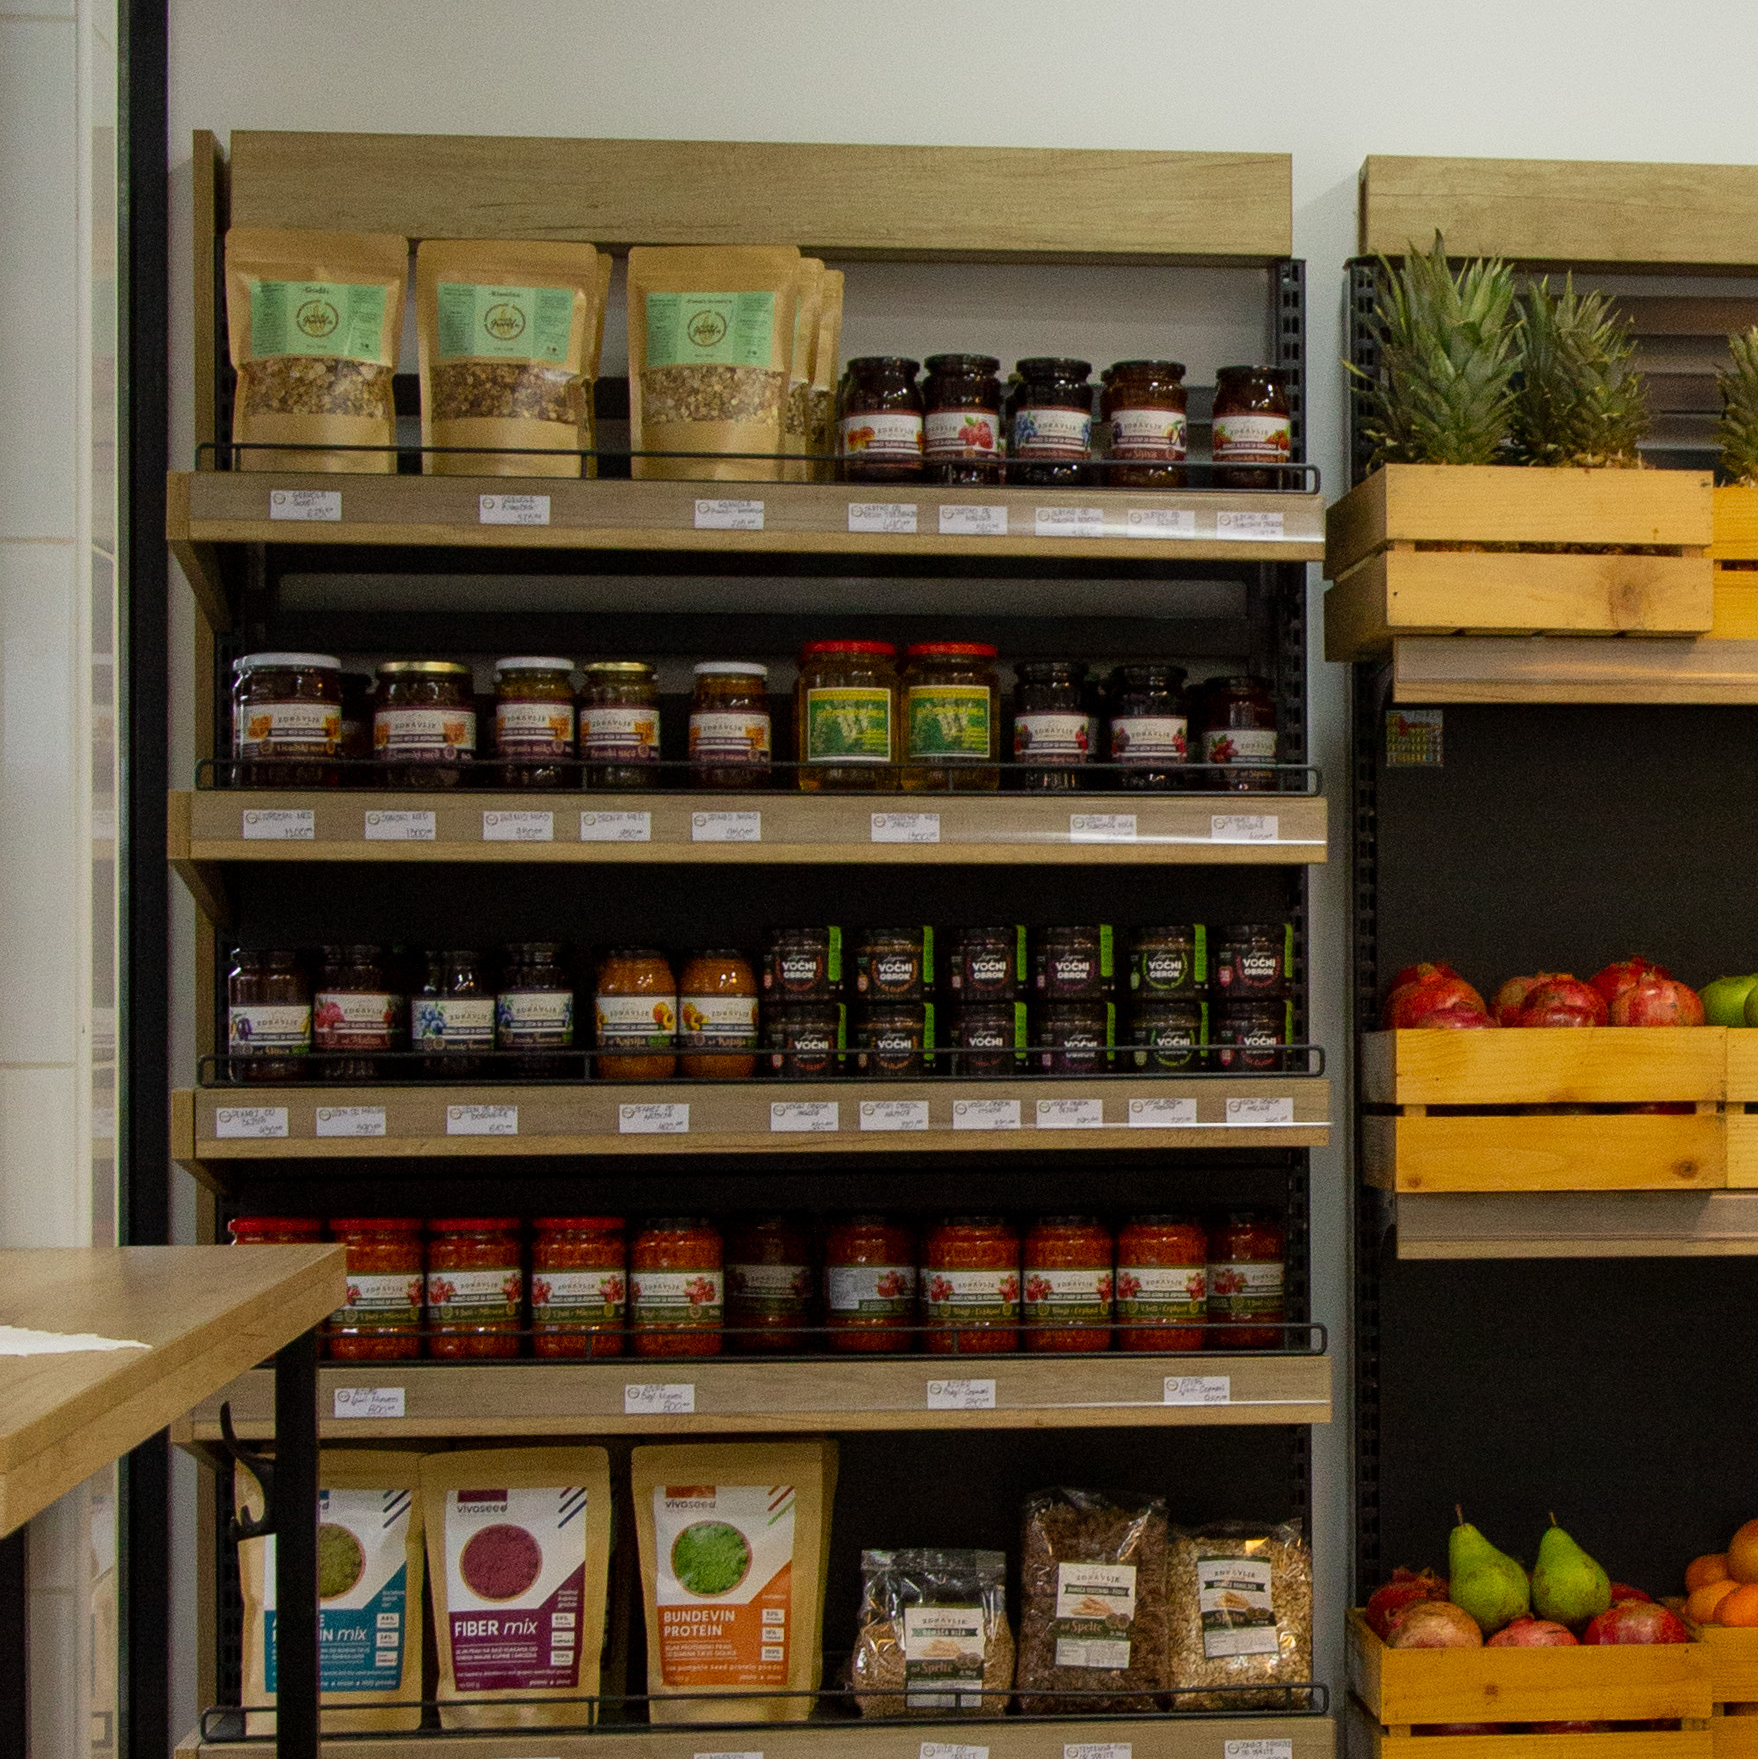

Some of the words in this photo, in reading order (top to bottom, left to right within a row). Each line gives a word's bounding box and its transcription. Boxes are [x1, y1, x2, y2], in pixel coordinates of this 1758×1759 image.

[782, 960, 817, 971] VOĆNI
[878, 962, 912, 972] VOĆNI
[972, 961, 1006, 972] VOĆNI
[1056, 960, 1090, 971] VOĆNI
[1148, 960, 1182, 970] VOĆNI
[1242, 958, 1276, 968] VOĆNI
[457, 1504, 508, 1514] vivoseed
[666, 1500, 716, 1510] vivoseed
[664, 1610, 735, 1623] BUNDEVIN
[454, 1620, 498, 1638] FIBER
[504, 1618, 538, 1636] mix
[664, 1625, 722, 1638] PROTEIN
[336, 1628, 366, 1641] mix
